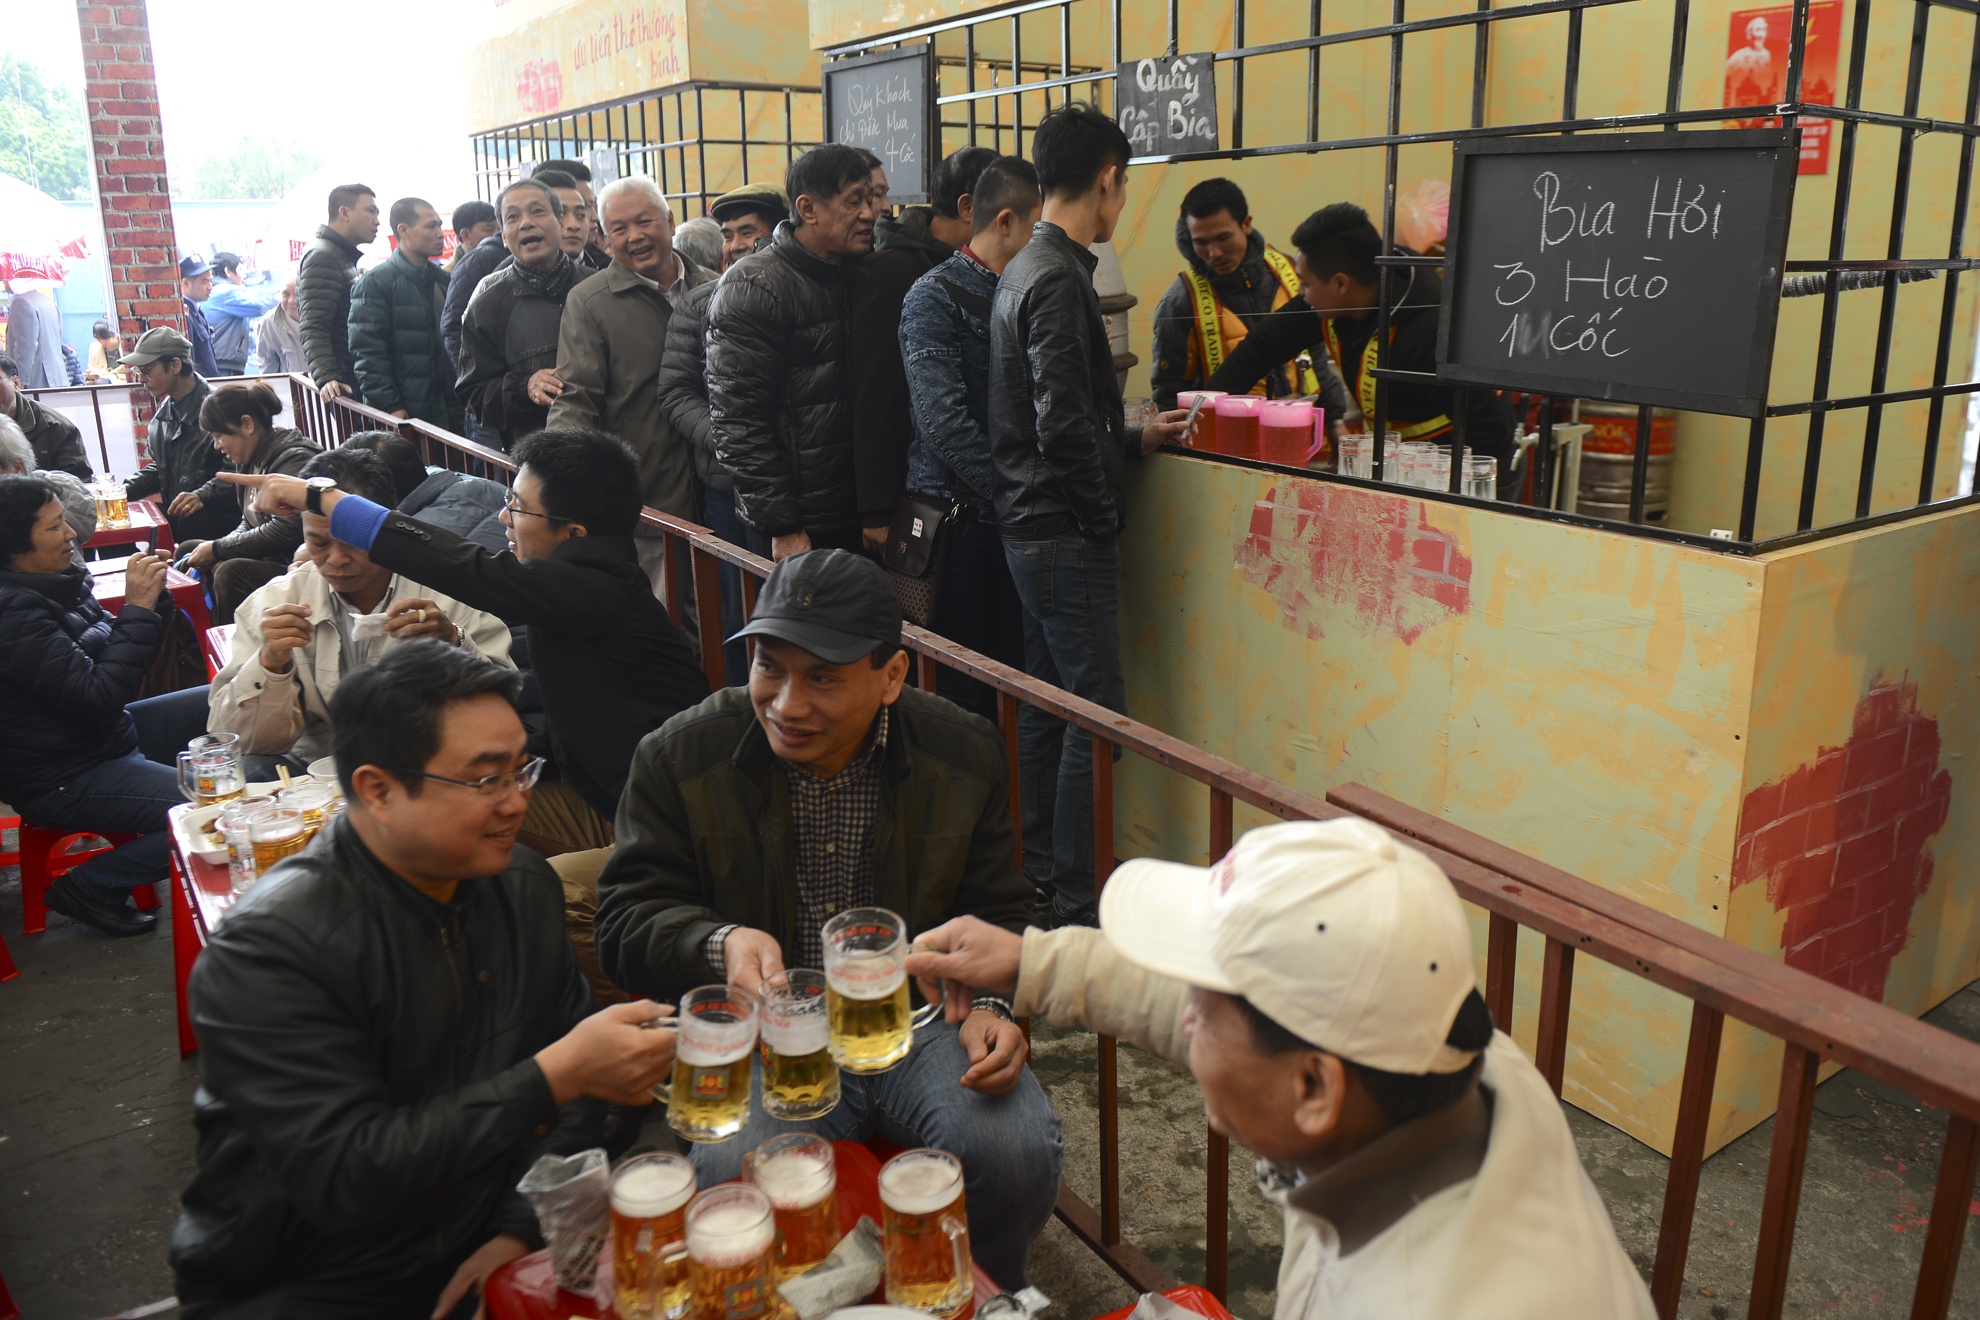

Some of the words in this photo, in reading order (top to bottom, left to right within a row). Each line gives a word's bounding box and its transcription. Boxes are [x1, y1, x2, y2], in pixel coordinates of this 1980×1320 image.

[875, 74, 913, 109] Khách
[1135, 55, 1200, 107] Quầy
[886, 109, 909, 132] Mua
[1167, 99, 1217, 140] Bia
[884, 135, 899, 173] 4
[1533, 170, 1616, 254] Bia
[1493, 261, 1537, 307] 3
[1204, 318, 1221, 373] TRADIN
[1499, 313, 1520, 359] 1
[1549, 306, 1631, 358] Cốc
